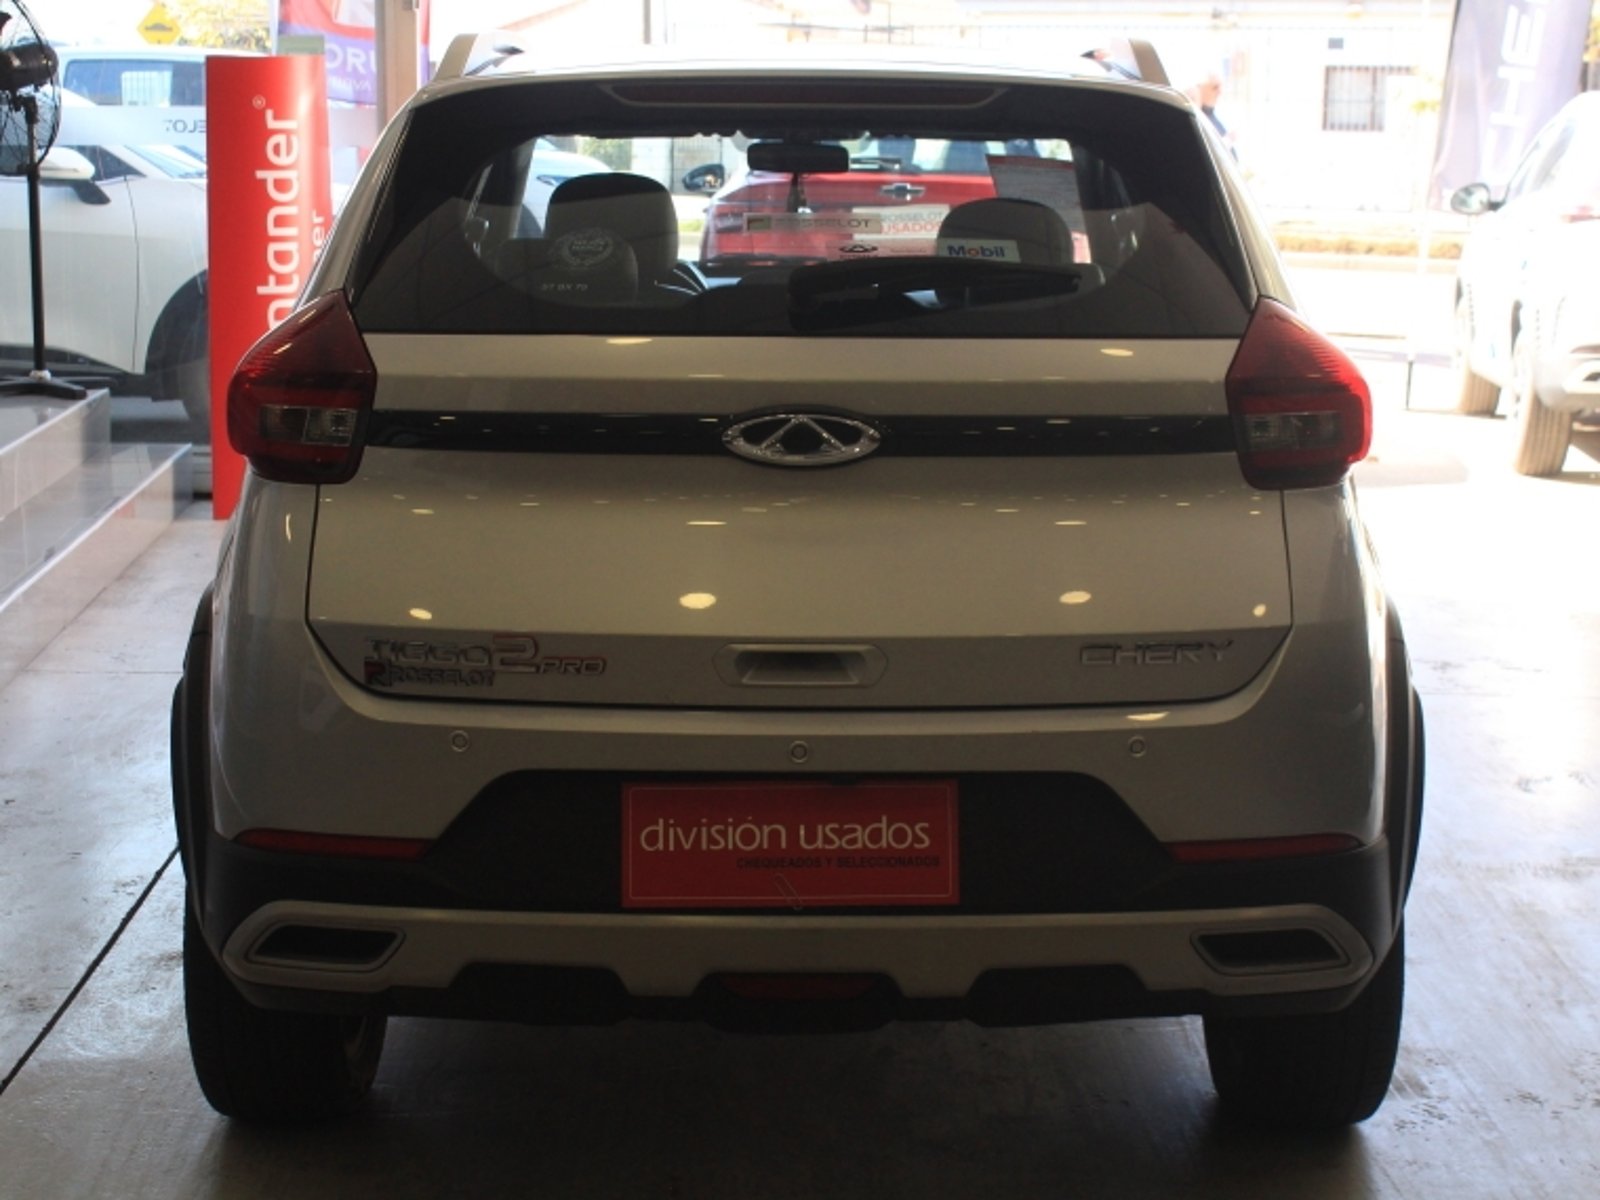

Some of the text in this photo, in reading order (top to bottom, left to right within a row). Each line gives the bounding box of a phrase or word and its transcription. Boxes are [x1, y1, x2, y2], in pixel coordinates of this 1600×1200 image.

[947, 244, 1006, 258] Mobil
[1080, 640, 1235, 666] CHERY
[540, 656, 607, 675] PRO
[640, 815, 931, 851] división usados
[736, 855, 940, 870] CHEQUEADOS Y SELECCIONADOS
